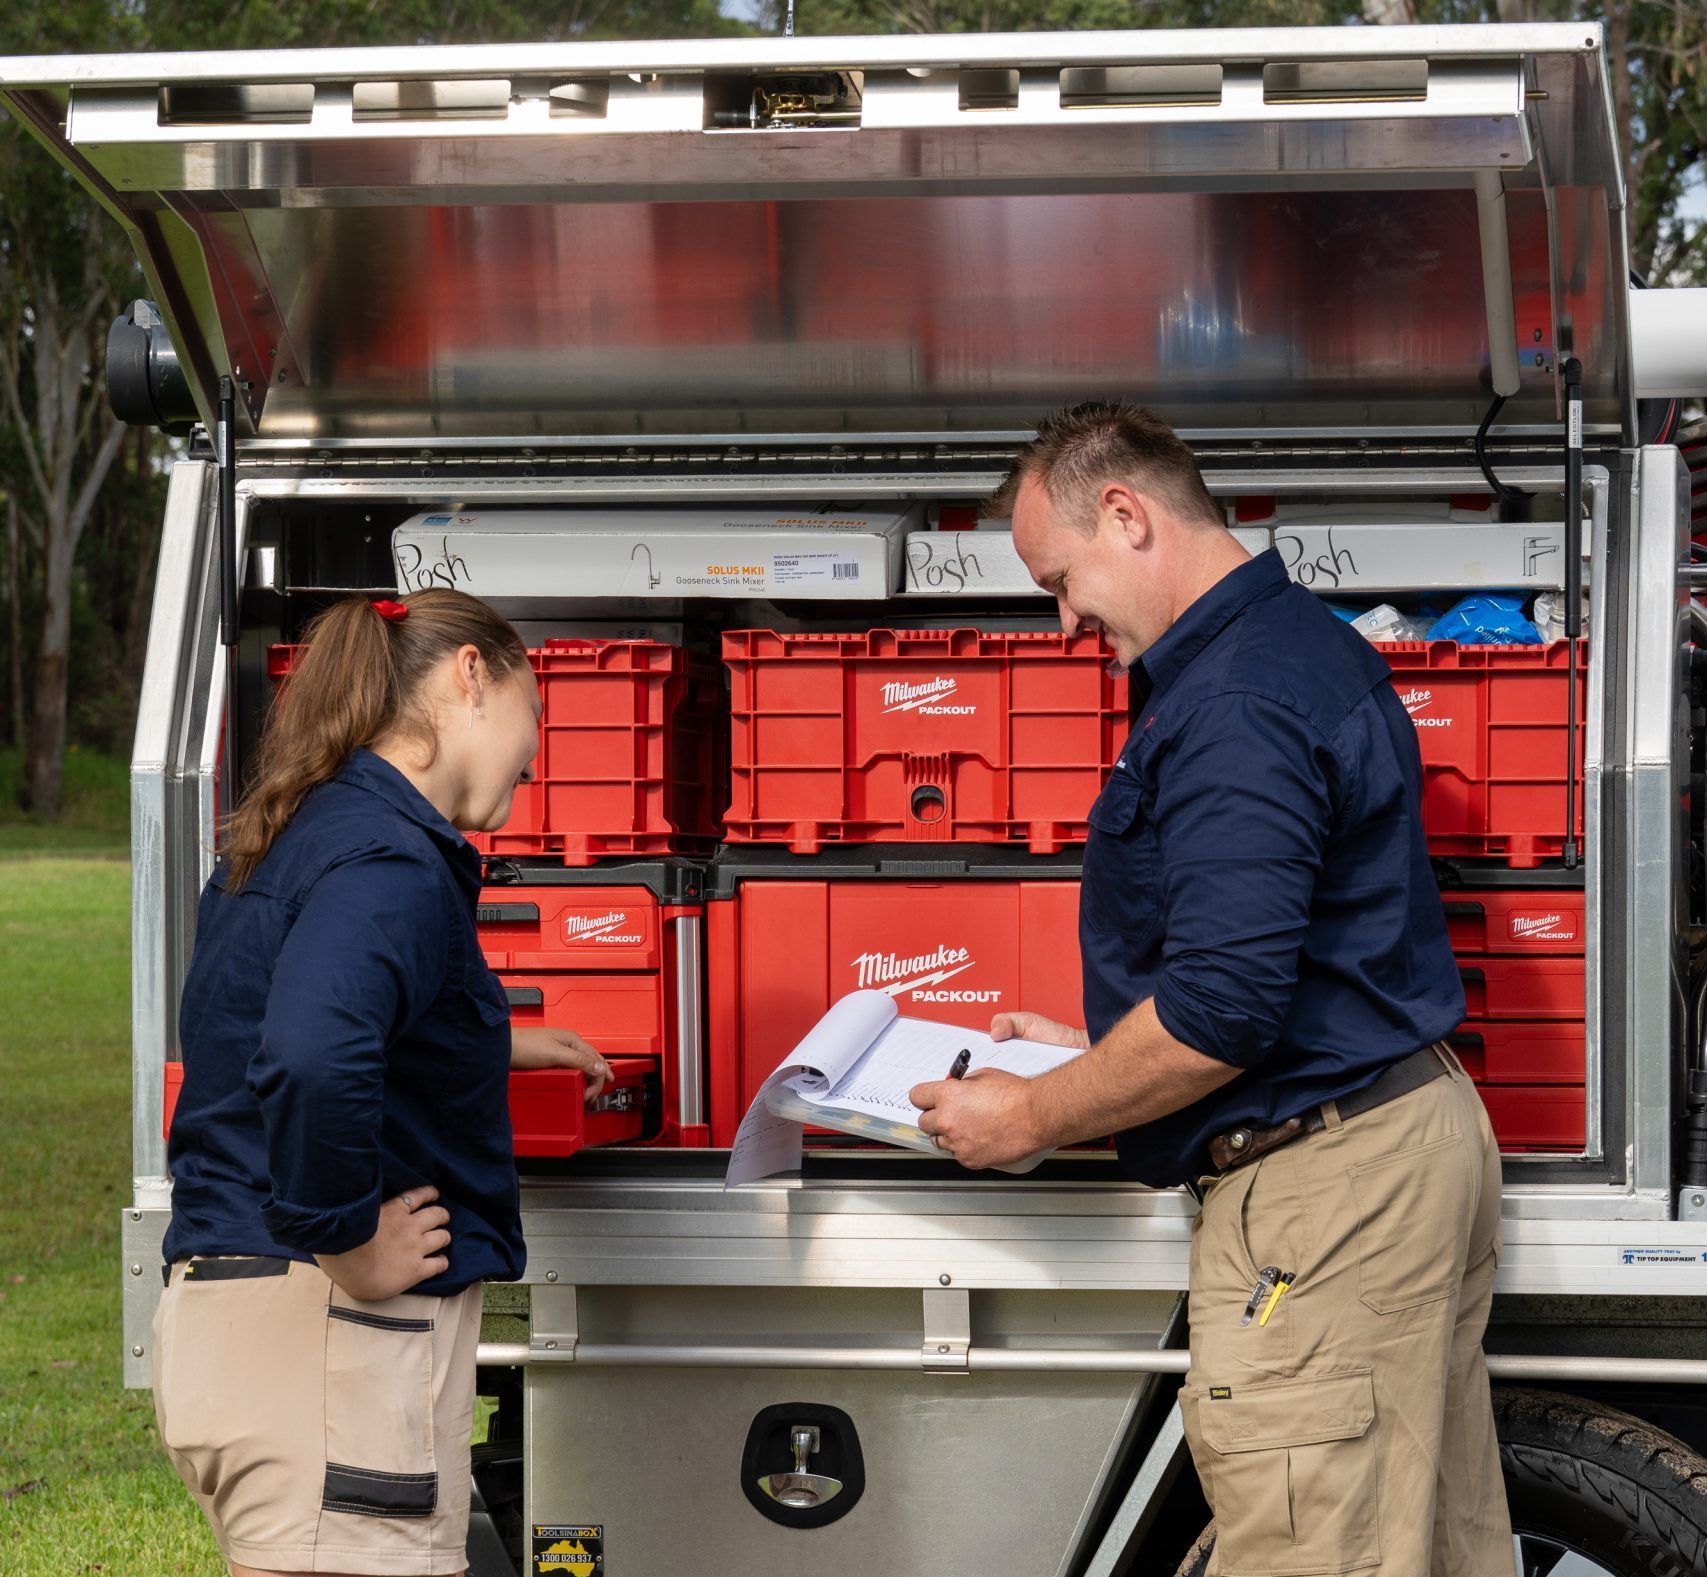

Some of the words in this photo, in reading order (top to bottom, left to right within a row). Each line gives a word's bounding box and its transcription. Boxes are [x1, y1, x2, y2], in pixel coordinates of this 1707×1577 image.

[394, 535, 472, 593] Posh
[906, 532, 984, 593] Posh
[706, 566, 740, 575] SOLUS
[741, 566, 765, 576] MKII
[676, 576, 721, 585] Gooseneck
[722, 576, 741, 585] Sink
[742, 577, 766, 586] Mixer
[879, 676, 957, 706] Milwaukee
[918, 706, 977, 715] PACKOUT
[1411, 718, 1453, 727] CKOUT
[563, 911, 626, 936] Milwaukee
[1512, 914, 1561, 933] Milwaukee
[595, 935, 642, 943] PACKOUT
[850, 944, 970, 989] Milwaukee
[911, 990, 1002, 1003] PACKOUT
[541, 1554, 560, 1562] 1300
[561, 1554, 576, 1562] 026
[577, 1554, 592, 1562] 937
